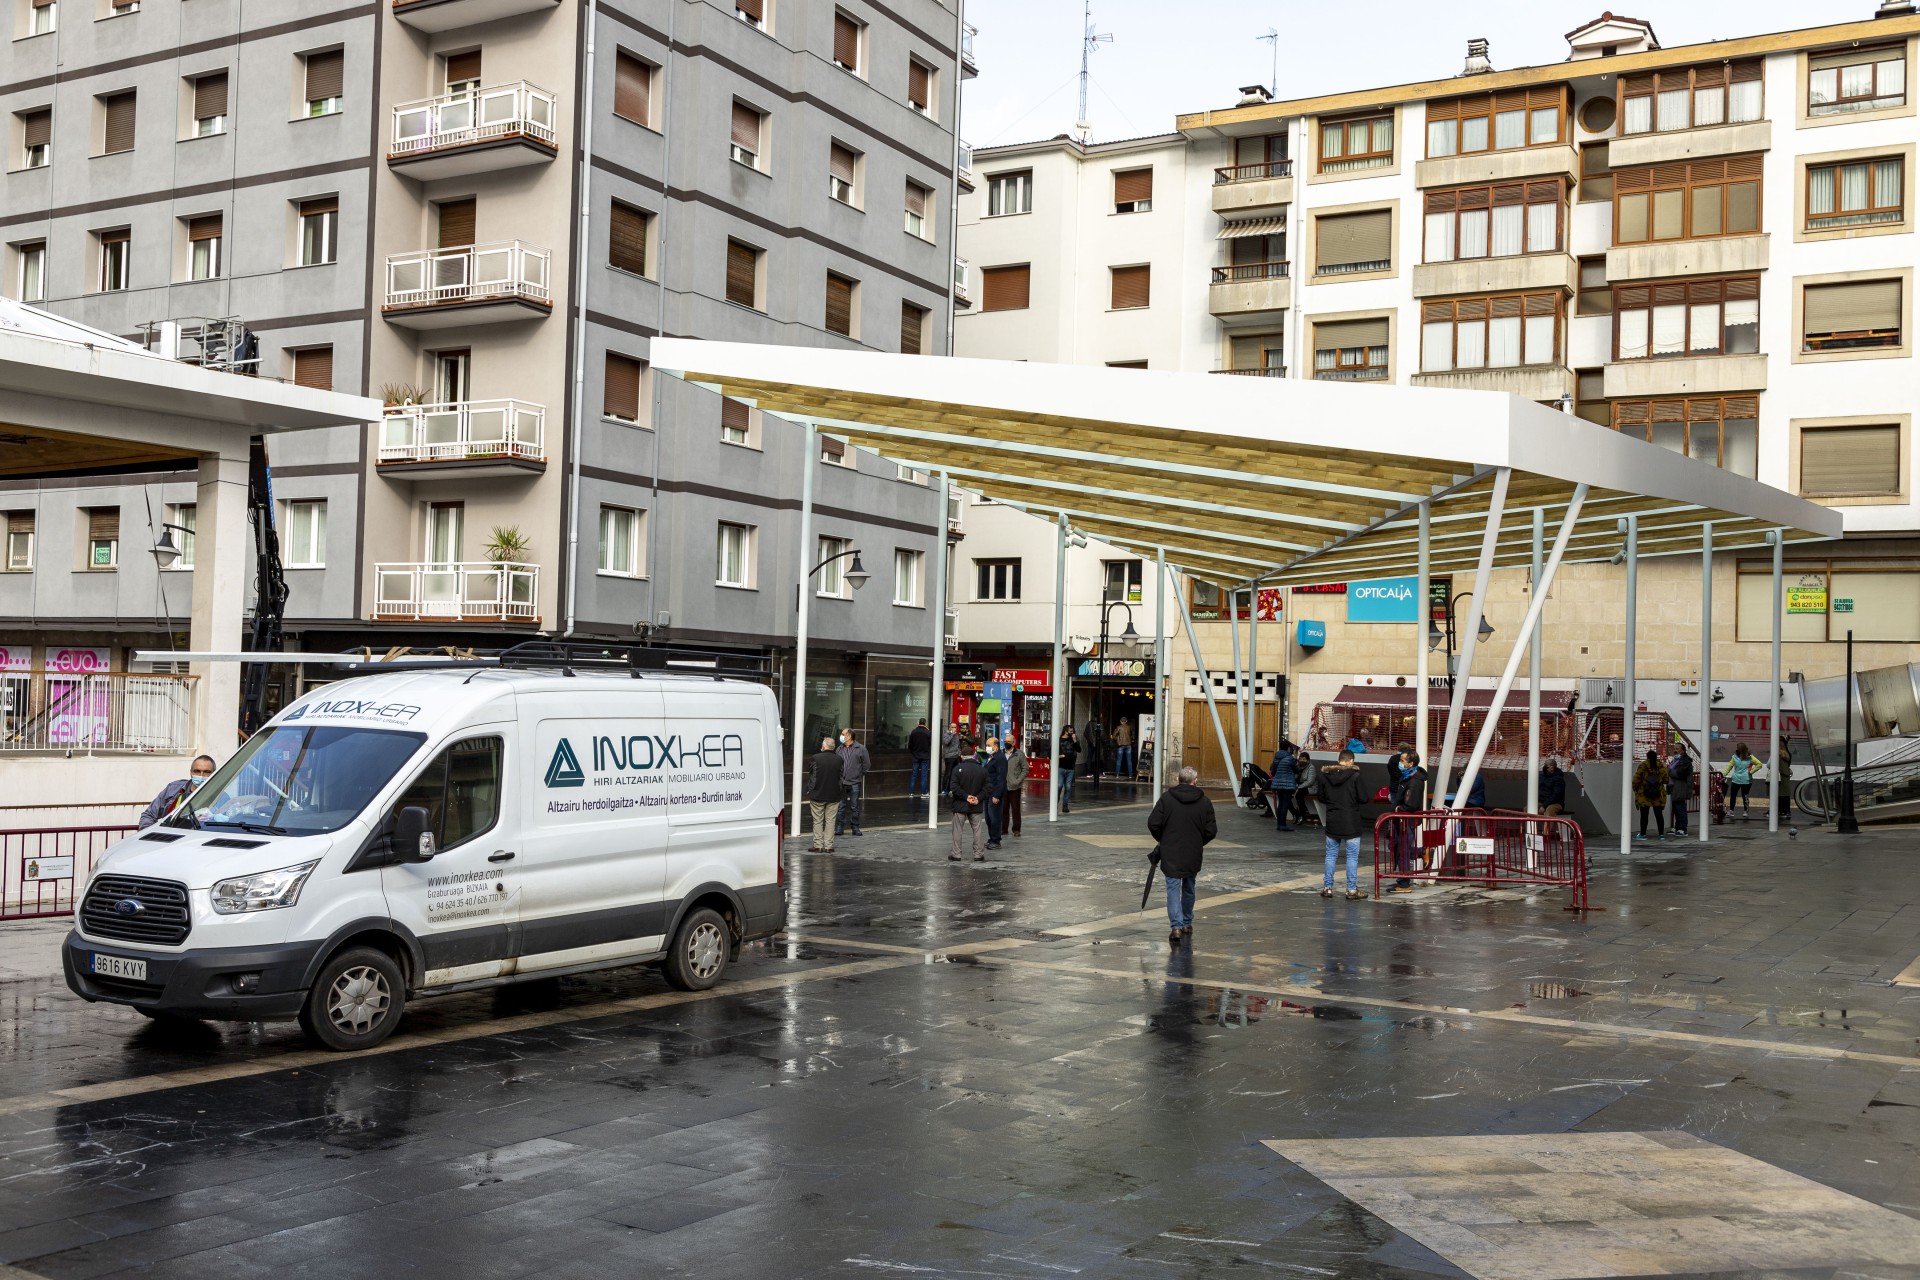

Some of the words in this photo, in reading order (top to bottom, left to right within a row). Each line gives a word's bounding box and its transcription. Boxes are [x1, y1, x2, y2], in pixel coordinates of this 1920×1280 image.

[994, 670, 1017, 679] FAST
[594, 778, 613, 786] HIRI
[615, 775, 664, 786] ALTZARIAK
[668, 774, 714, 783] MOBILIARIO
[715, 772, 746, 781] URBANO
[548, 801, 581, 813] Altzairu
[582, 797, 634, 812] herdoilgaitza
[702, 791, 724, 803] Burdin
[725, 790, 743, 801] lanak
[428, 869, 504, 887] www.inoxkea.com
[436, 901, 444, 911] 94
[457, 899, 464, 908] 35
[427, 908, 490, 924] inoxkea@inoxkea.com
[97, 956, 120, 974] 9616
[123, 960, 144, 978] KVY
